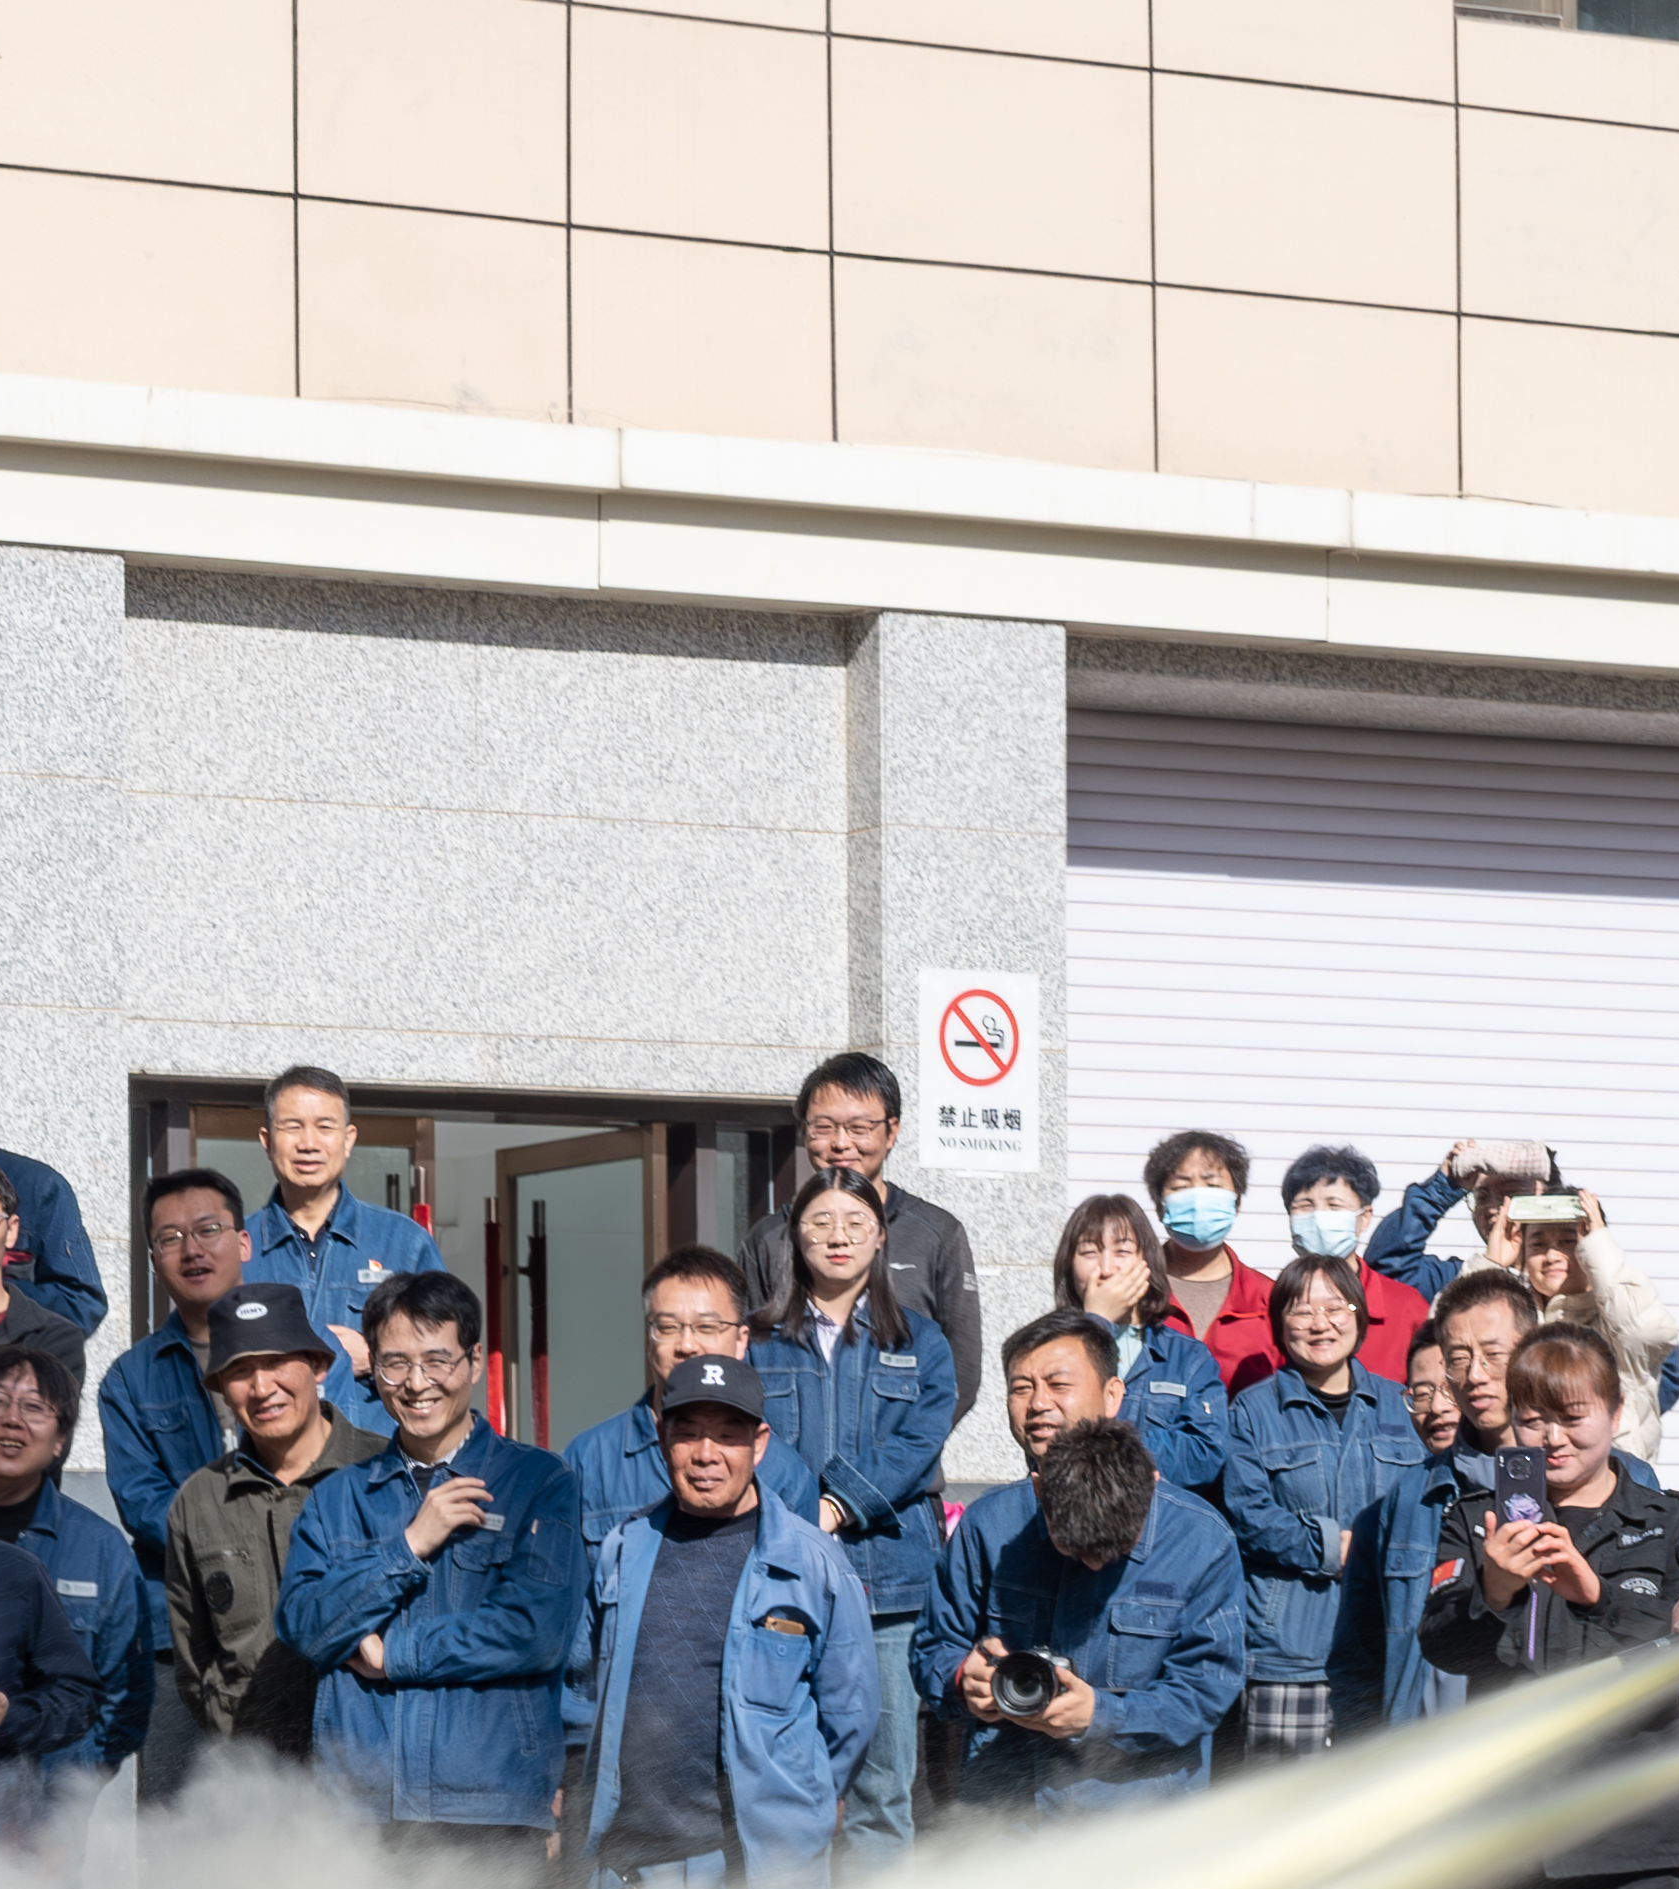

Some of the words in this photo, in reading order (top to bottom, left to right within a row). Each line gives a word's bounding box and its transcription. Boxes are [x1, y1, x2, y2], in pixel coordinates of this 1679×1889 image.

[938, 1105, 1021, 1131] 禁止吸烟
[938, 1136, 957, 1149] NO
[959, 1137, 1021, 1152] SMOKING
[700, 1363, 726, 1386] R
